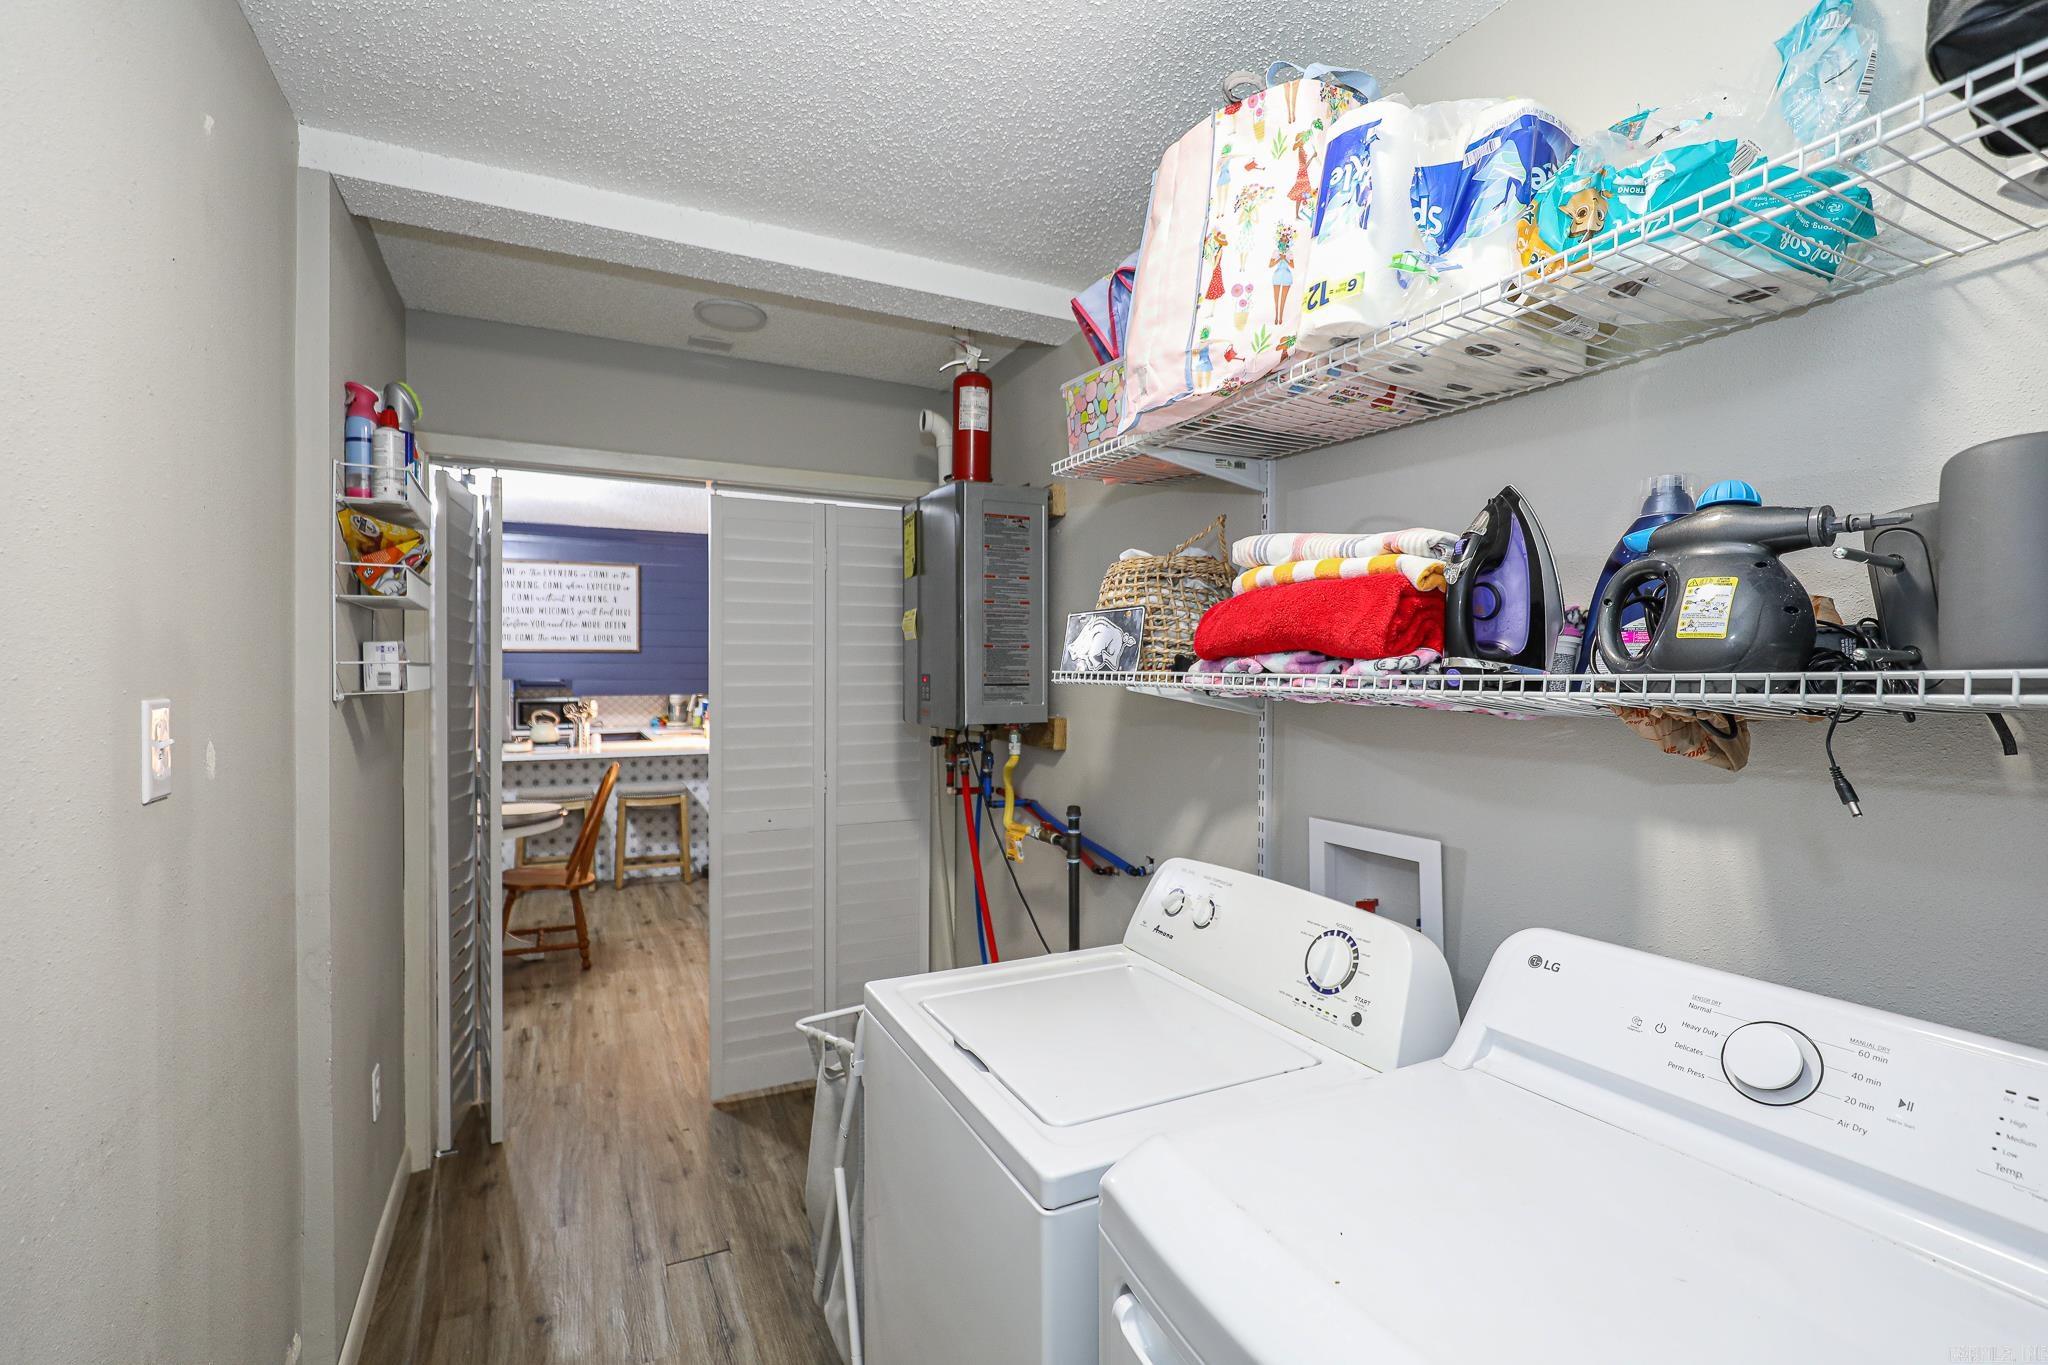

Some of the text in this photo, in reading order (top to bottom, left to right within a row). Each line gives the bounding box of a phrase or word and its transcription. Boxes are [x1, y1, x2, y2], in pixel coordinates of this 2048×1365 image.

[1617, 186, 1645, 195] TRONG
[1347, 278, 1358, 292] 6
[1307, 280, 1330, 311] 12
[588, 570, 608, 578] COME
[542, 581, 562, 590] COME
[586, 582, 621, 591] EXPECTED
[511, 593, 533, 602] COME
[502, 606, 534, 615] OUSAND
[538, 607, 574, 615] WELCOMES
[530, 619, 545, 628] YOU
[581, 620, 600, 629] MORE
[604, 621, 627, 629] OFTEN
[515, 633, 533, 641] COME
[593, 634, 613, 642] ADORE
[617, 634, 632, 642] YOU
[1152, 924, 1174, 940] Amana
[1543, 959, 1561, 973] LG
[1354, 995, 1371, 1006] START
[1688, 1002, 1713, 1014] Normal
[1681, 1020, 1719, 1039] Heavy Duty
[1674, 1041, 1704, 1056] Delicates
[1848, 1037, 1891, 1054] MANUAL DRY
[1858, 1049, 1889, 1064] 60 min
[1686, 1067, 1705, 1079] Press
[1851, 1072, 1882, 1087] 40 min
[1844, 1095, 1875, 1112] 20 min
[1836, 1119, 1868, 1136] Air Dry
[2006, 1133, 2038, 1148] Medium
[2002, 1150, 2018, 1159] Low
